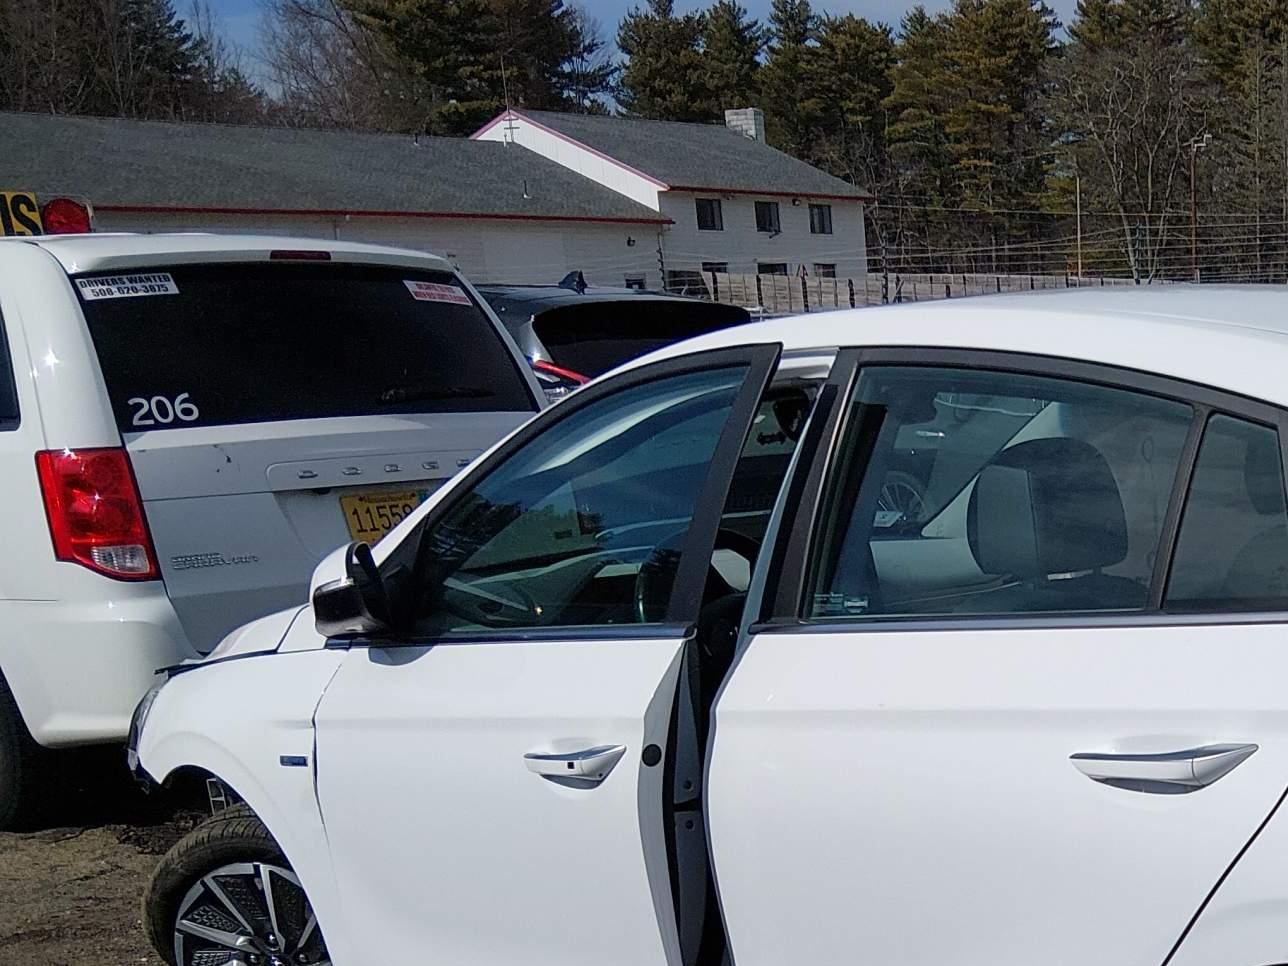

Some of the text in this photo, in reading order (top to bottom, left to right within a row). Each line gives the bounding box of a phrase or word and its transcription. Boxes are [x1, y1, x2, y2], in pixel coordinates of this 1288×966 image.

[79, 274, 170, 288] DRIVERS WANTED
[127, 392, 199, 426] 206
